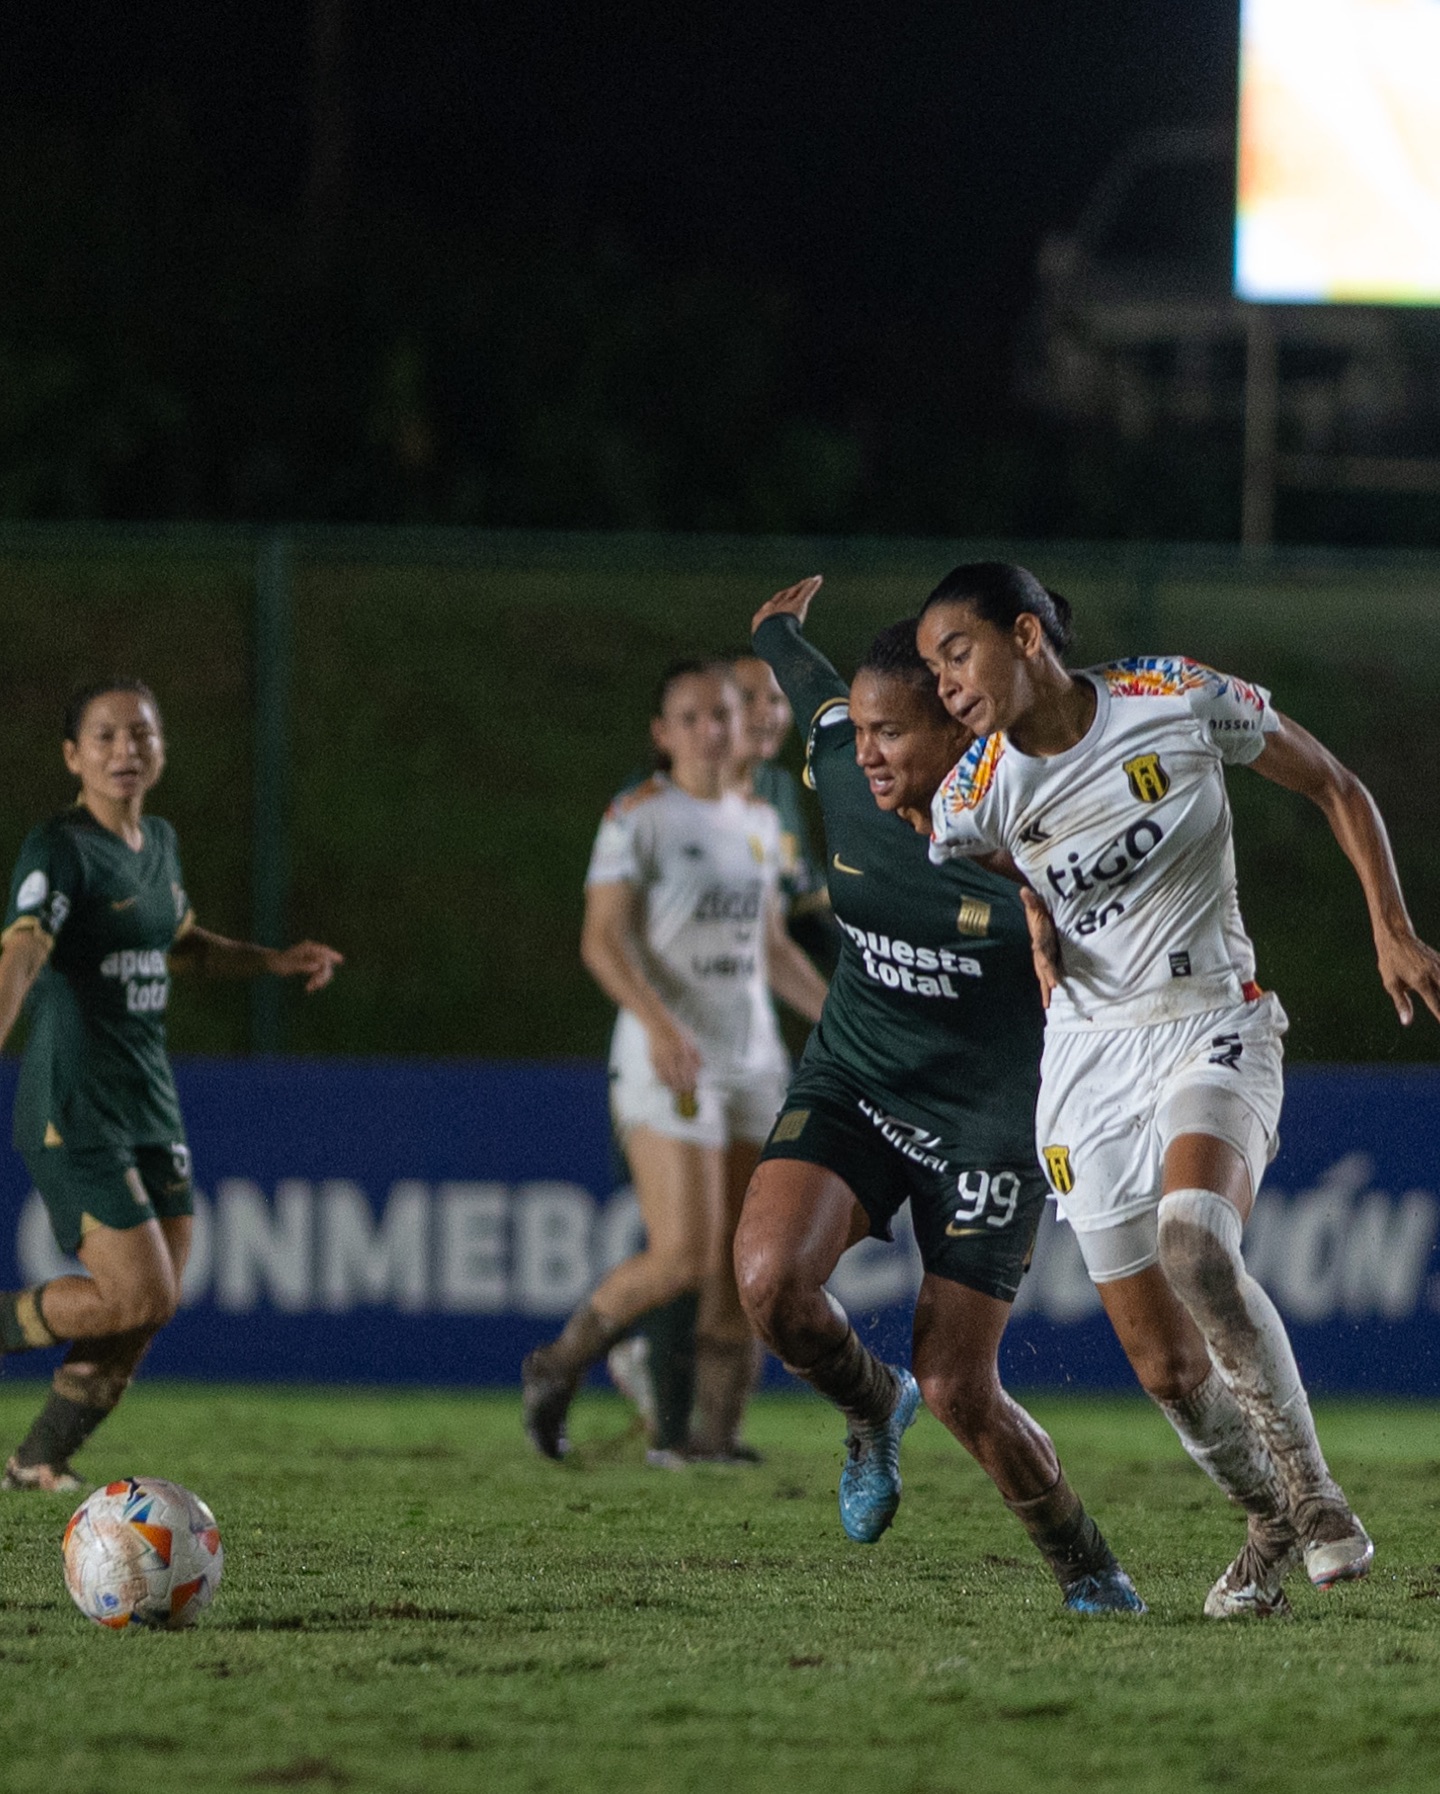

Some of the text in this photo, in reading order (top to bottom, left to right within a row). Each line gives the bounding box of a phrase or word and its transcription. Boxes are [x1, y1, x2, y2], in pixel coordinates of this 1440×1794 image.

[1046, 819, 1164, 901] tigo
[862, 948, 959, 1000] total
[954, 1169, 1021, 1228] 99
